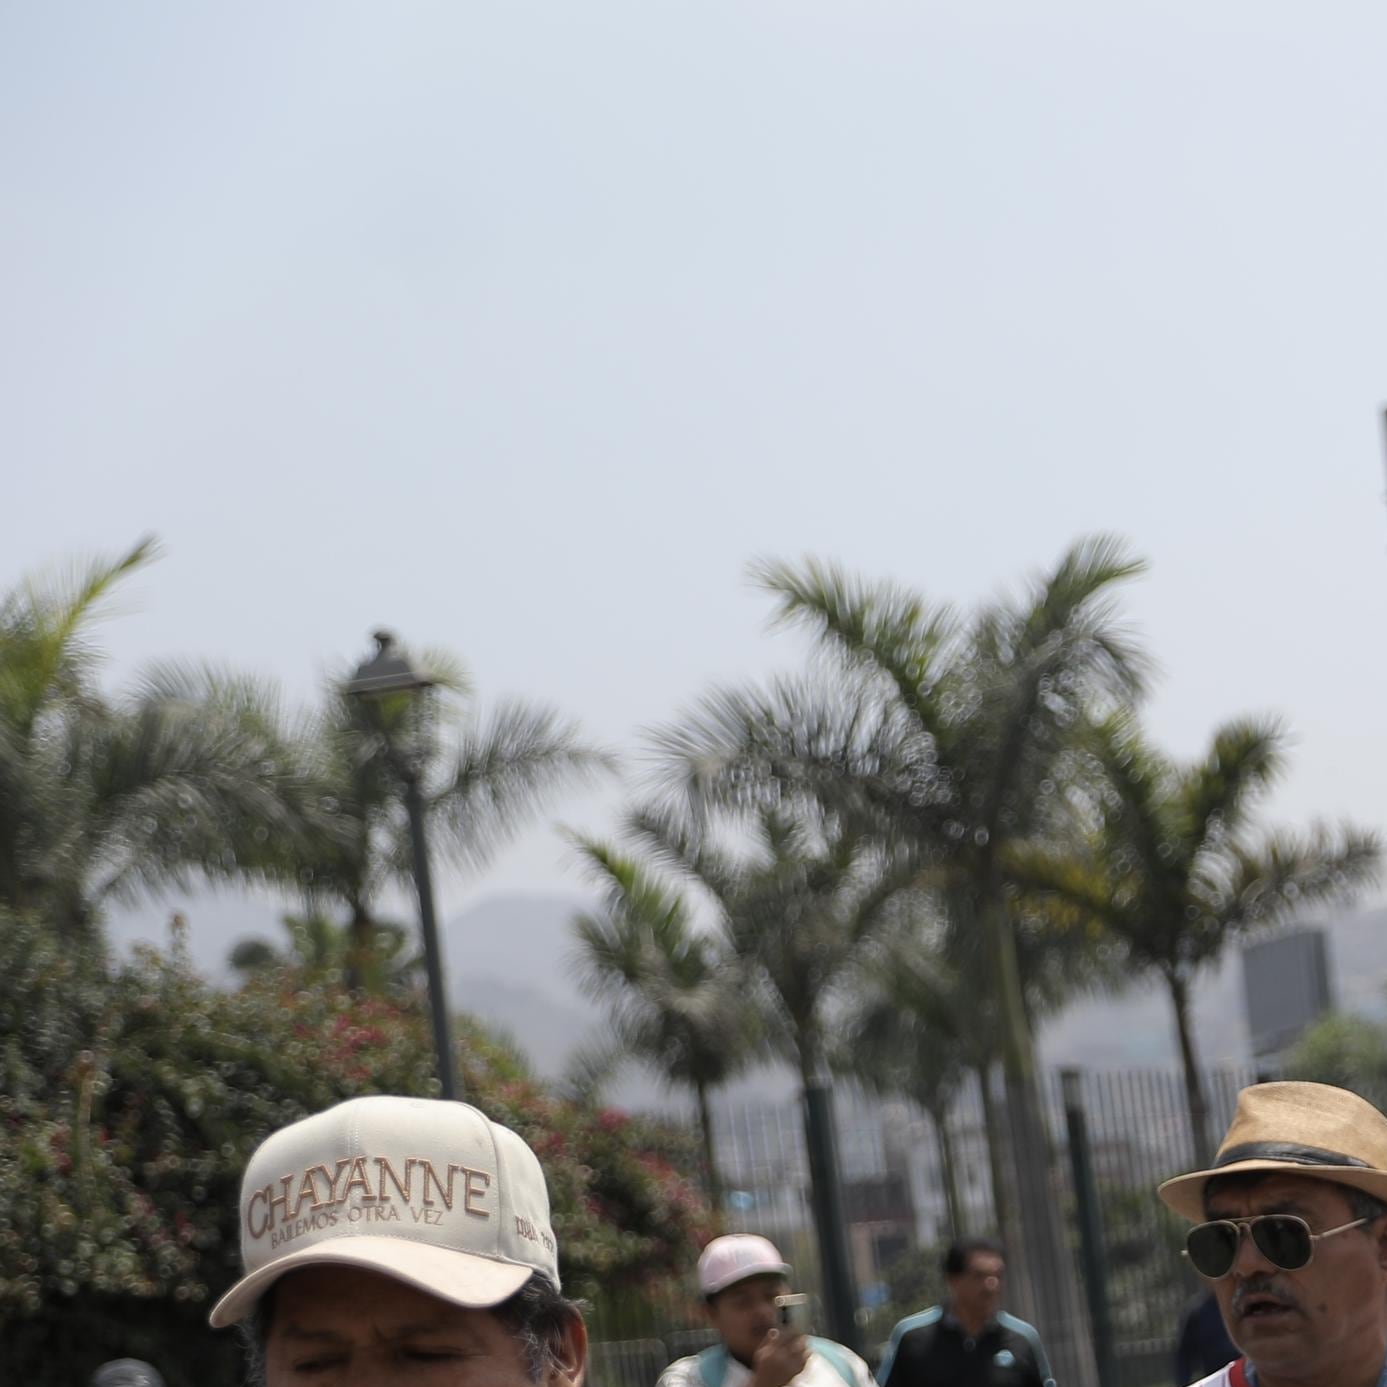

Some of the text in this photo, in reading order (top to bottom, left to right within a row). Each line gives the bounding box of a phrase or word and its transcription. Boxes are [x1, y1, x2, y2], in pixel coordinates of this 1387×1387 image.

[247, 1155, 491, 1240] CHAYANNE
[271, 1204, 445, 1250] BAILEMOS OTRA VEZ
